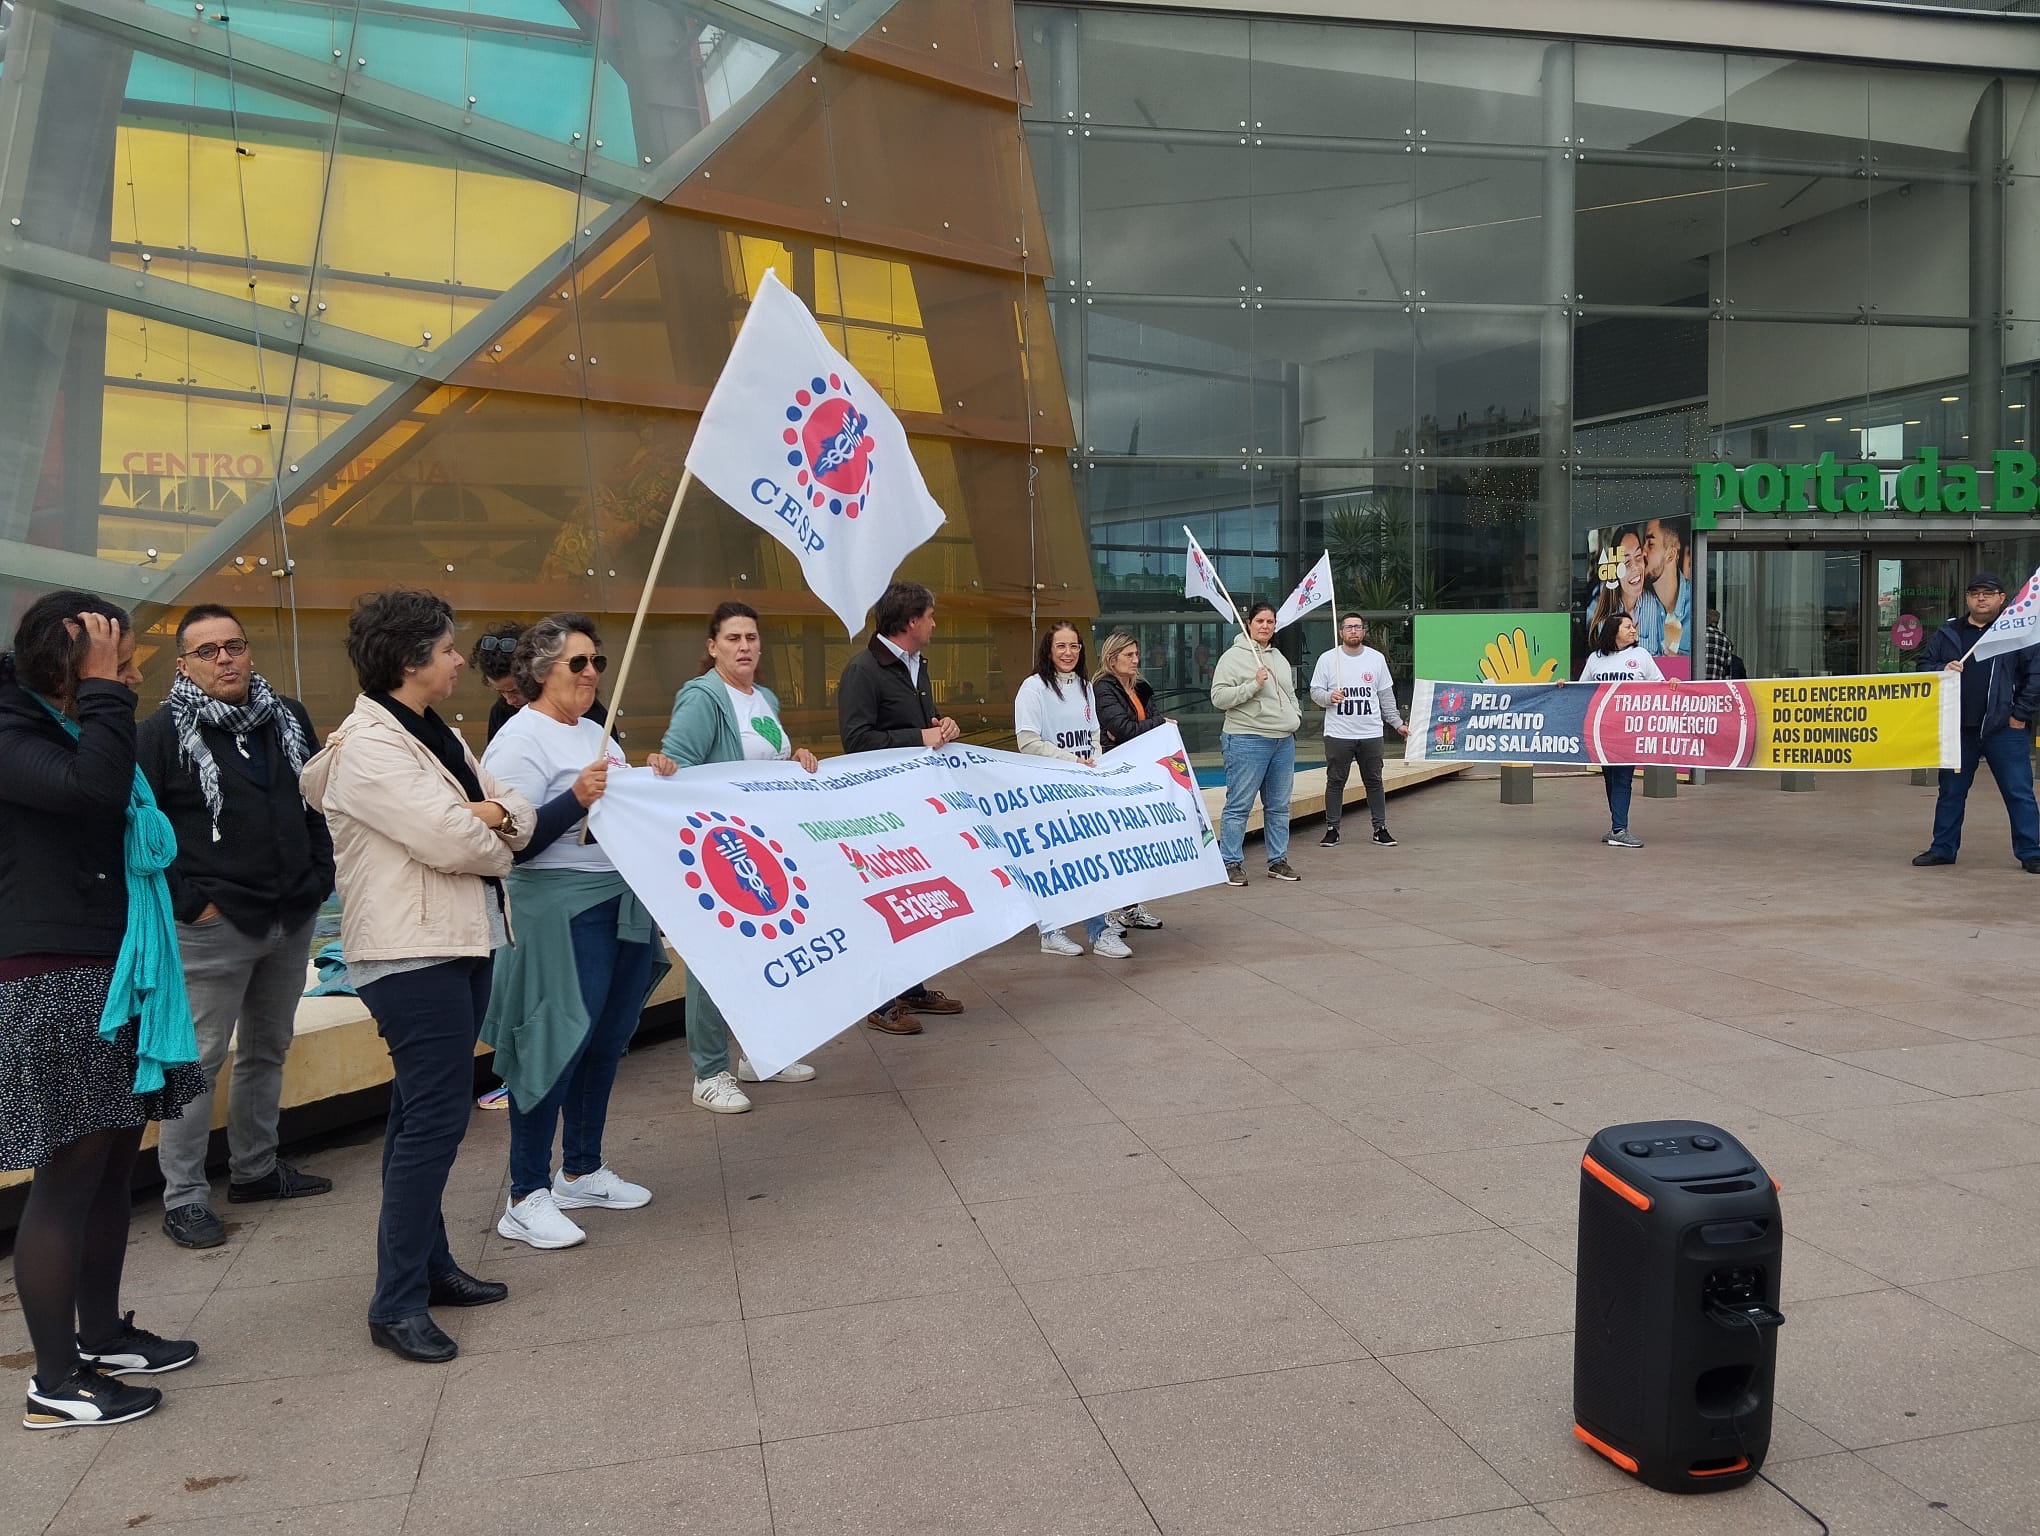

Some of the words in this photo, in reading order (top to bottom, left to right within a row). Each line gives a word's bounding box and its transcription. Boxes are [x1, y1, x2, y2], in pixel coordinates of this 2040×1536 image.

[122, 452, 264, 478] CENTRO
[1692, 451, 1884, 529] porta
[1896, 447, 1982, 512] da
[1991, 450, 2040, 512] B
[750, 477, 825, 556] CESP
[1340, 687, 1371, 697] OMOS
[1470, 693, 1511, 710] PELO
[1773, 687, 1808, 703] PELO
[1810, 682, 1932, 702] ENCERRAMENTO
[1337, 700, 1372, 716] LUTA
[1614, 694, 1733, 713] TRABALHADORES
[1773, 708, 1791, 723] DO
[1794, 704, 1867, 723] COMÉRCIO
[1466, 713, 1544, 730] AUMENTO
[1624, 715, 1643, 733] DO
[1647, 713, 1718, 735] COMÉRCIO
[1056, 729, 1092, 749] SOMOS
[1464, 734, 1497, 752] DOS
[1500, 732, 1580, 754] SALÁRIOS
[1772, 728, 1800, 743] AOS
[1803, 727, 1878, 743] DOMINGOS
[1635, 737, 1658, 754] EM
[1662, 737, 1705, 757] LUTA!
[1773, 748, 1780, 763] E
[1784, 748, 1852, 764] FERIADOS
[728, 778, 794, 792] Sindicato
[810, 765, 904, 791] Trabalhadores
[993, 787, 1029, 814] DAS
[1029, 783, 1096, 804] CARREIRAS
[798, 814, 890, 842] TRABALHADORES
[879, 811, 905, 830] DO
[1003, 827, 1035, 858] DE
[1034, 809, 1111, 850] SALÁRIO
[1107, 805, 1150, 832] PARA
[1146, 801, 1187, 826] TODOS
[1108, 836, 1199, 876] DESREGULADOS
[763, 927, 850, 988] CESP
